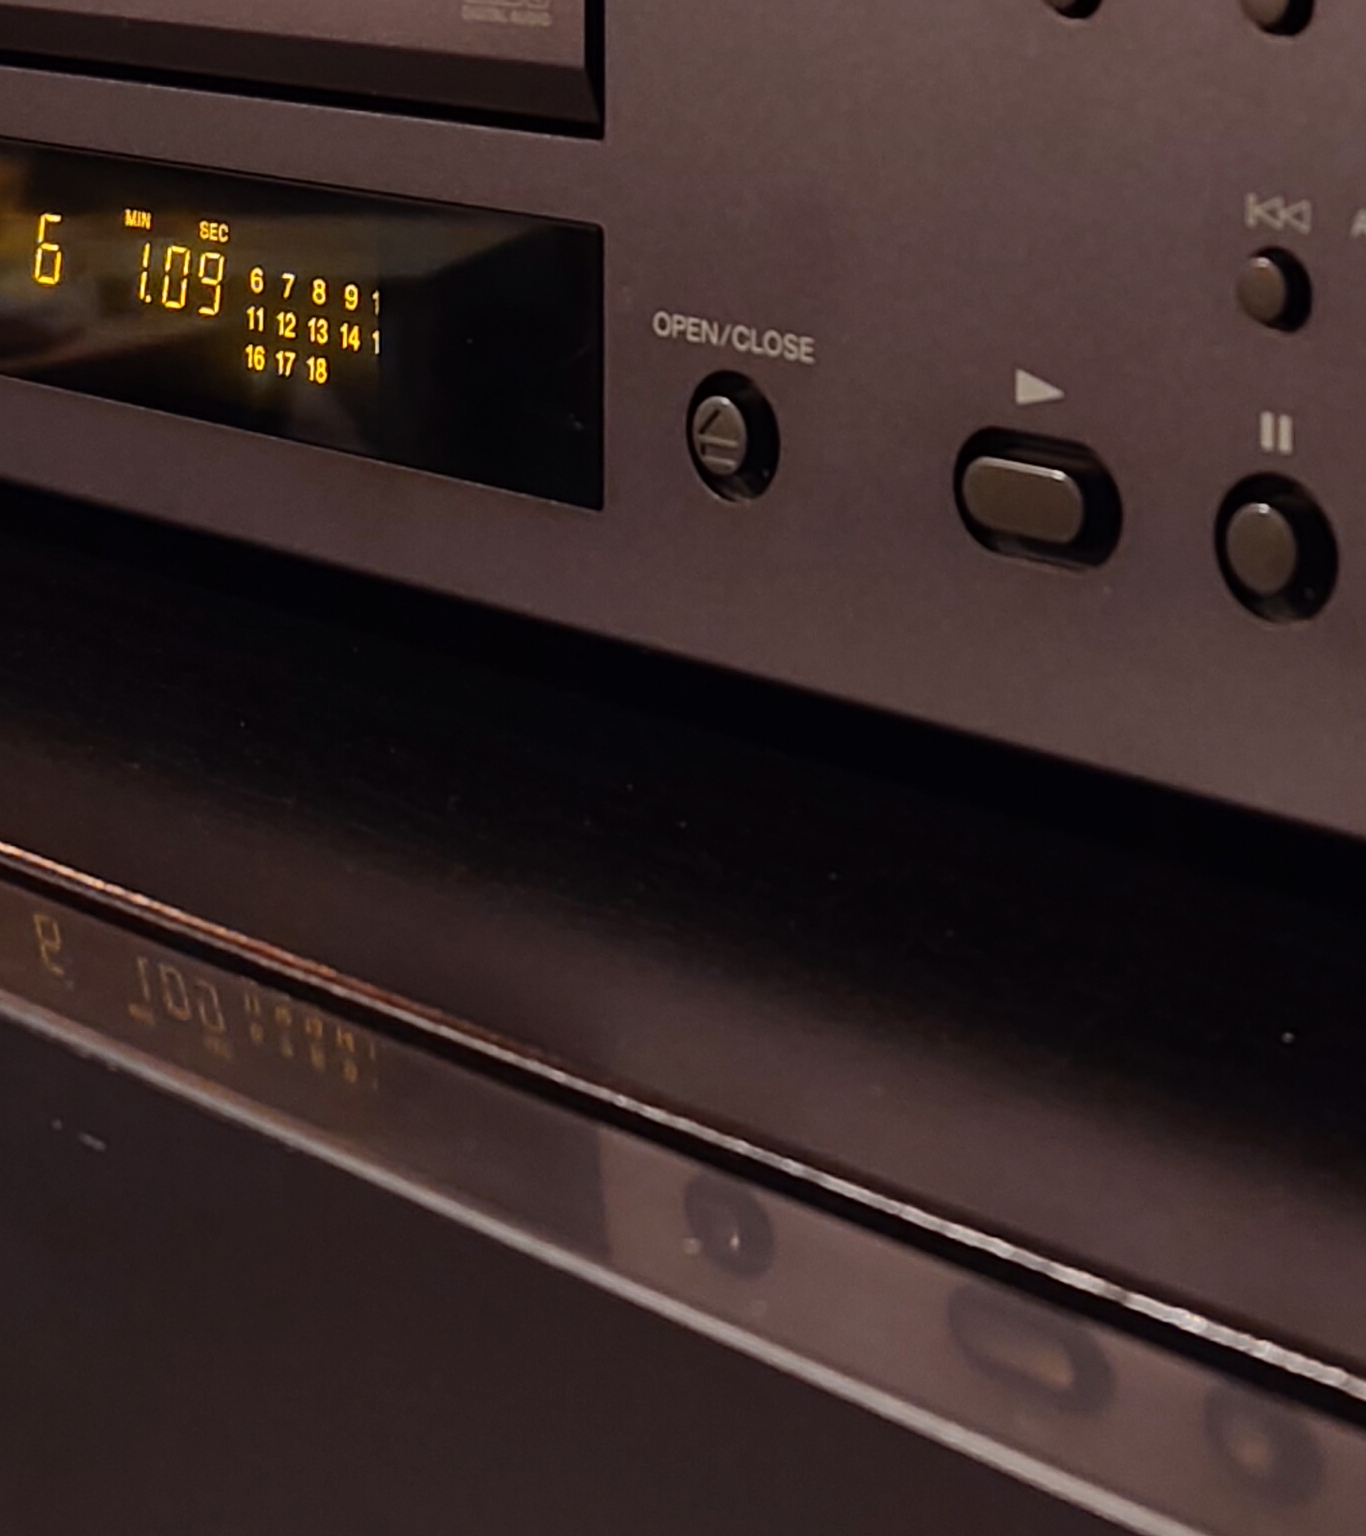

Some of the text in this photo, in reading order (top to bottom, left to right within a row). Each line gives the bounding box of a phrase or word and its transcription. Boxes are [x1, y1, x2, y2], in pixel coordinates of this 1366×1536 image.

[124, 208, 229, 243] MIN SEC
[35, 213, 62, 285] 6
[250, 267, 264, 294] 6
[281, 272, 296, 299] 7
[312, 278, 326, 305] 8
[344, 284, 359, 311] 9
[246, 305, 264, 332] 11
[276, 311, 297, 338] 12
[307, 317, 329, 344] 13
[340, 322, 361, 352] 14
[652, 310, 816, 365] OPEN/CLOSE
[245, 344, 328, 384] 16 17 18
